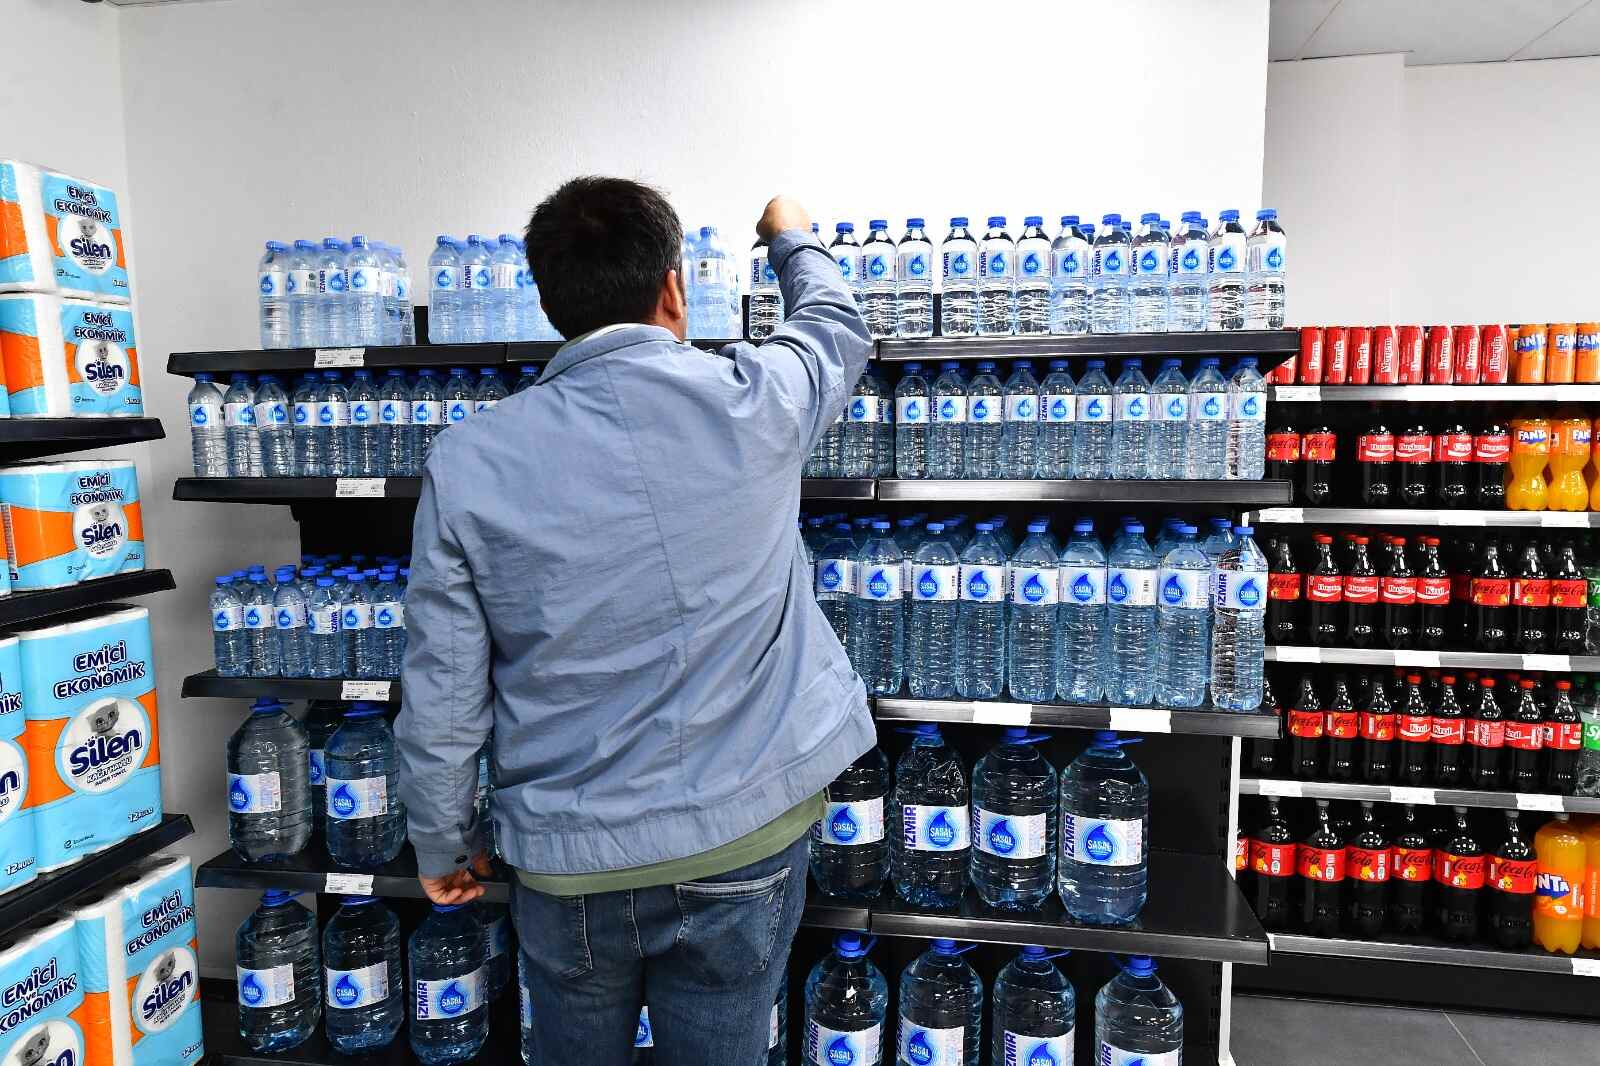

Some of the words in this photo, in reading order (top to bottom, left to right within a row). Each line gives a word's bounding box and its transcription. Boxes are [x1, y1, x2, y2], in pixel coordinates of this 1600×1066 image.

[70, 236, 111, 258] Silen
[85, 361, 123, 381] Silen
[81, 522, 122, 546] Silen
[920, 582, 937, 591] SASAL
[1025, 586, 1046, 595] SASAL
[74, 640, 127, 672] EMİCİ
[97, 665, 107, 674] ve
[54, 661, 145, 699] EKONOMİK
[69, 729, 143, 776] Silen
[334, 798, 353, 808] SASAL
[833, 822, 857, 833] SASAL
[930, 827, 953, 838] SASAL
[991, 832, 1013, 845] SASAL
[1087, 839, 1112, 852] SASAL
[141, 889, 182, 928] EMİCİ
[126, 904, 195, 956] EKONOMİK
[2, 957, 57, 1008] EMİCİ
[26, 992, 37, 1001] ve
[143, 970, 192, 1019] Silen
[243, 986, 261, 997] SASAL
[336, 988, 359, 998] SASAL
[0, 973, 77, 1034] KONOMİK
[441, 996, 463, 1008] SASAL
[829, 1049, 851, 1061] SASAL
[909, 1043, 931, 1059] SASAL
